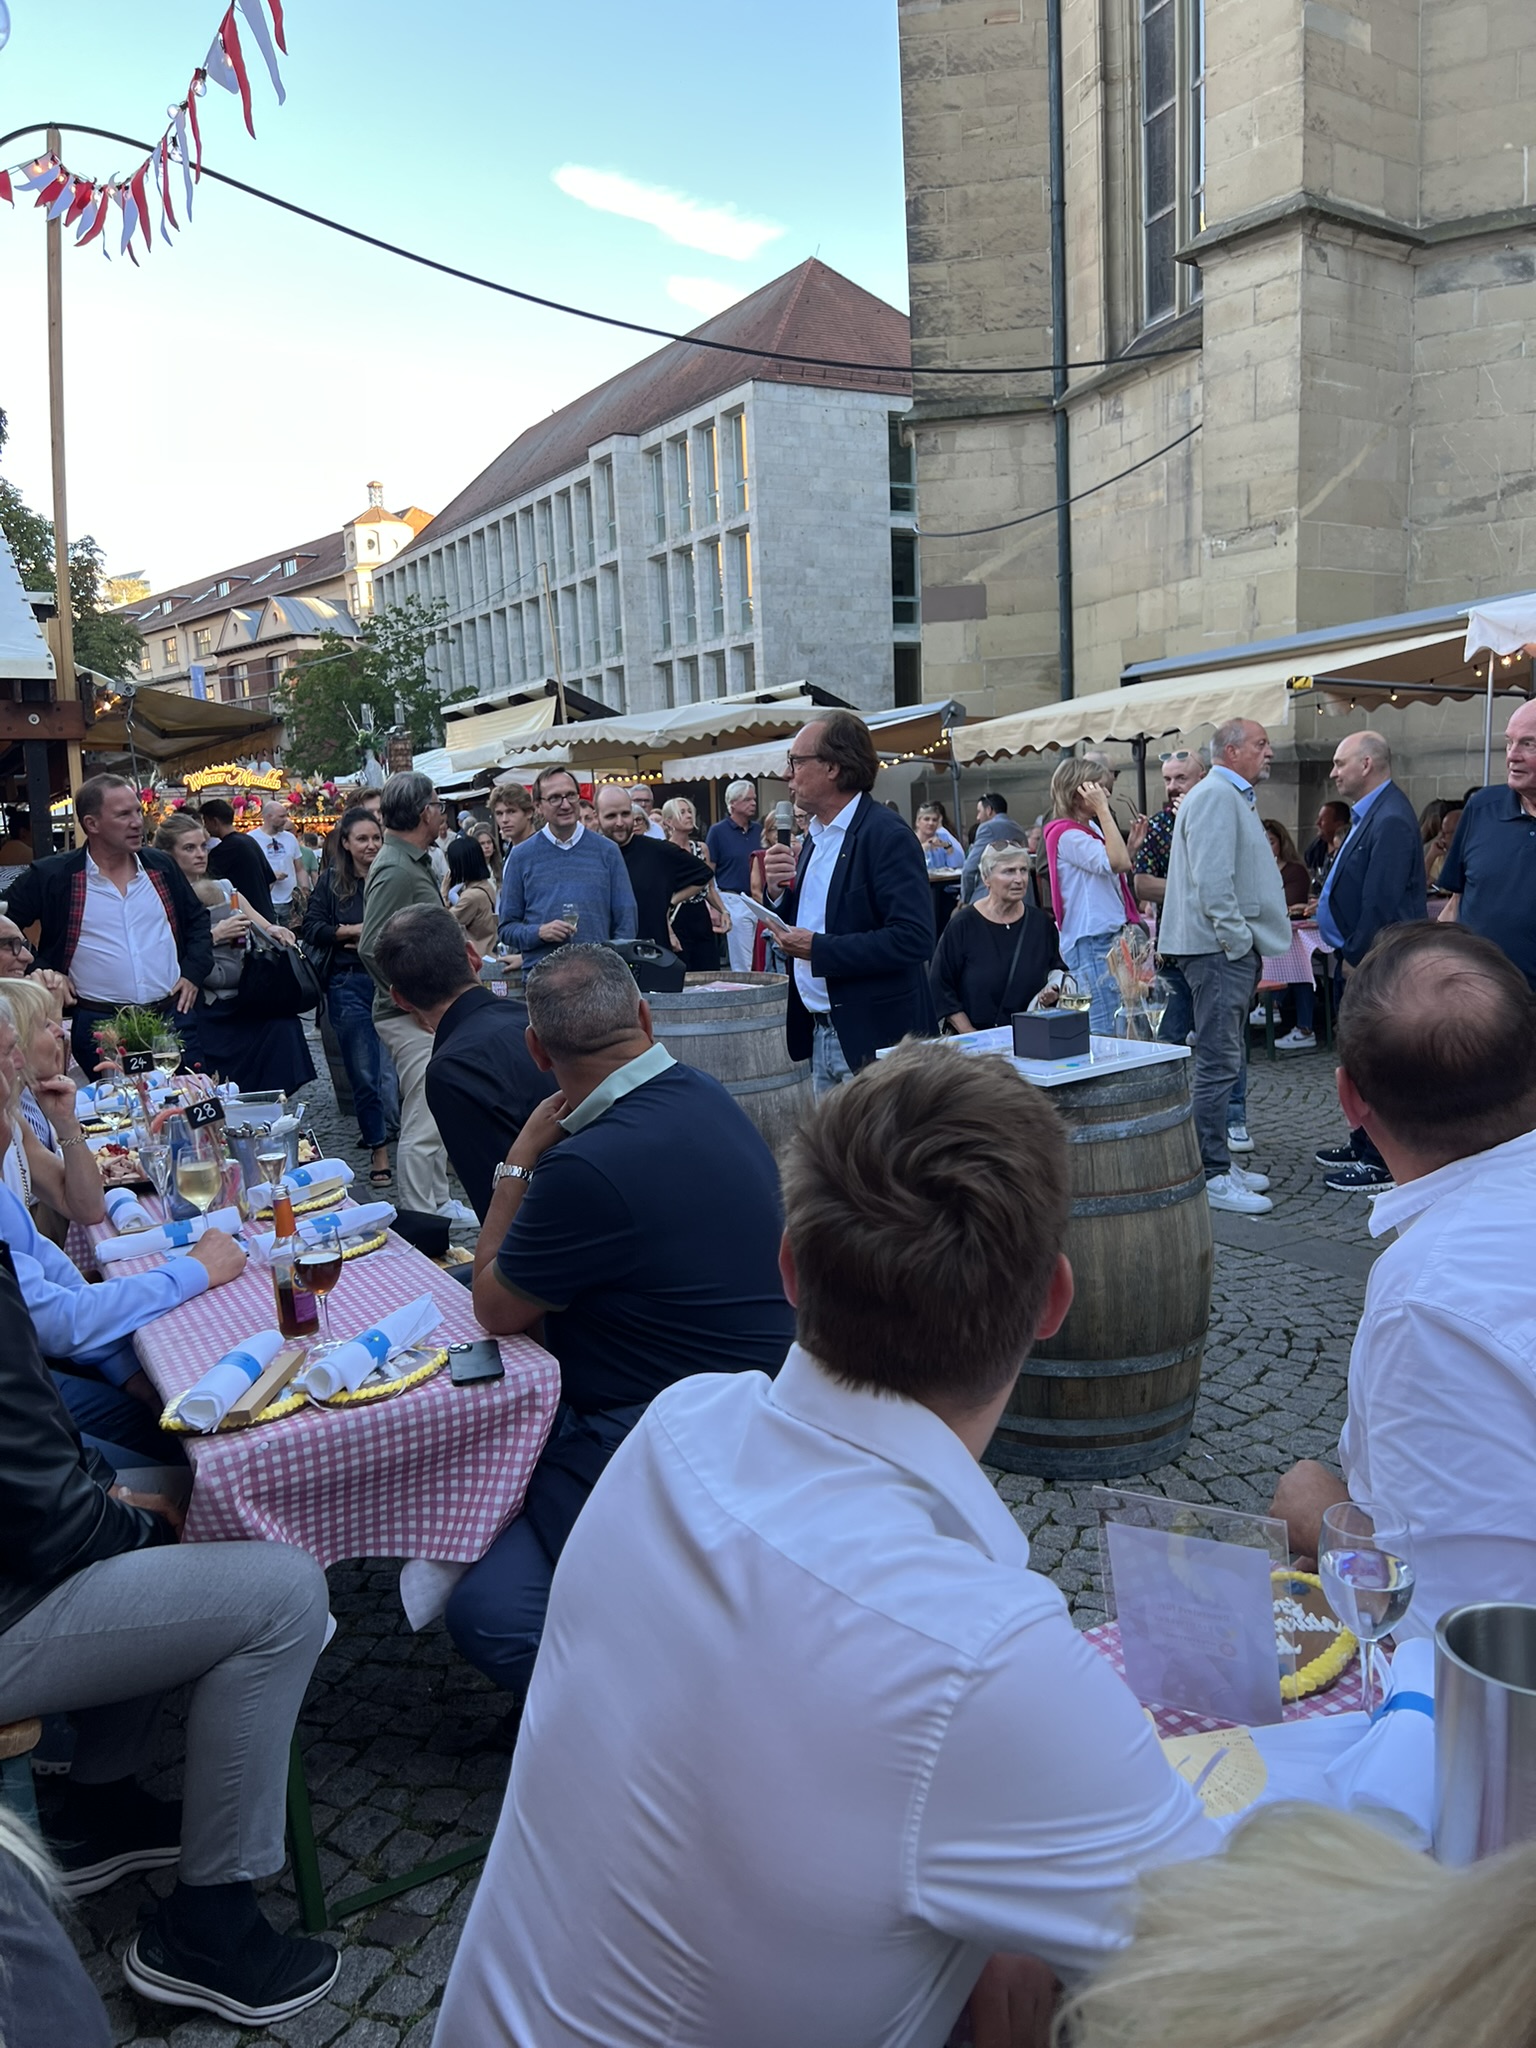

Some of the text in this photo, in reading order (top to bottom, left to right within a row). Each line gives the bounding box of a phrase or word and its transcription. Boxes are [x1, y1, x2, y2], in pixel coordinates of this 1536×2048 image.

[183, 770, 226, 792] Wiener
[226, 767, 284, 790] Mandeln
[129, 1056, 147, 1070] 24
[193, 1103, 217, 1122] 28
